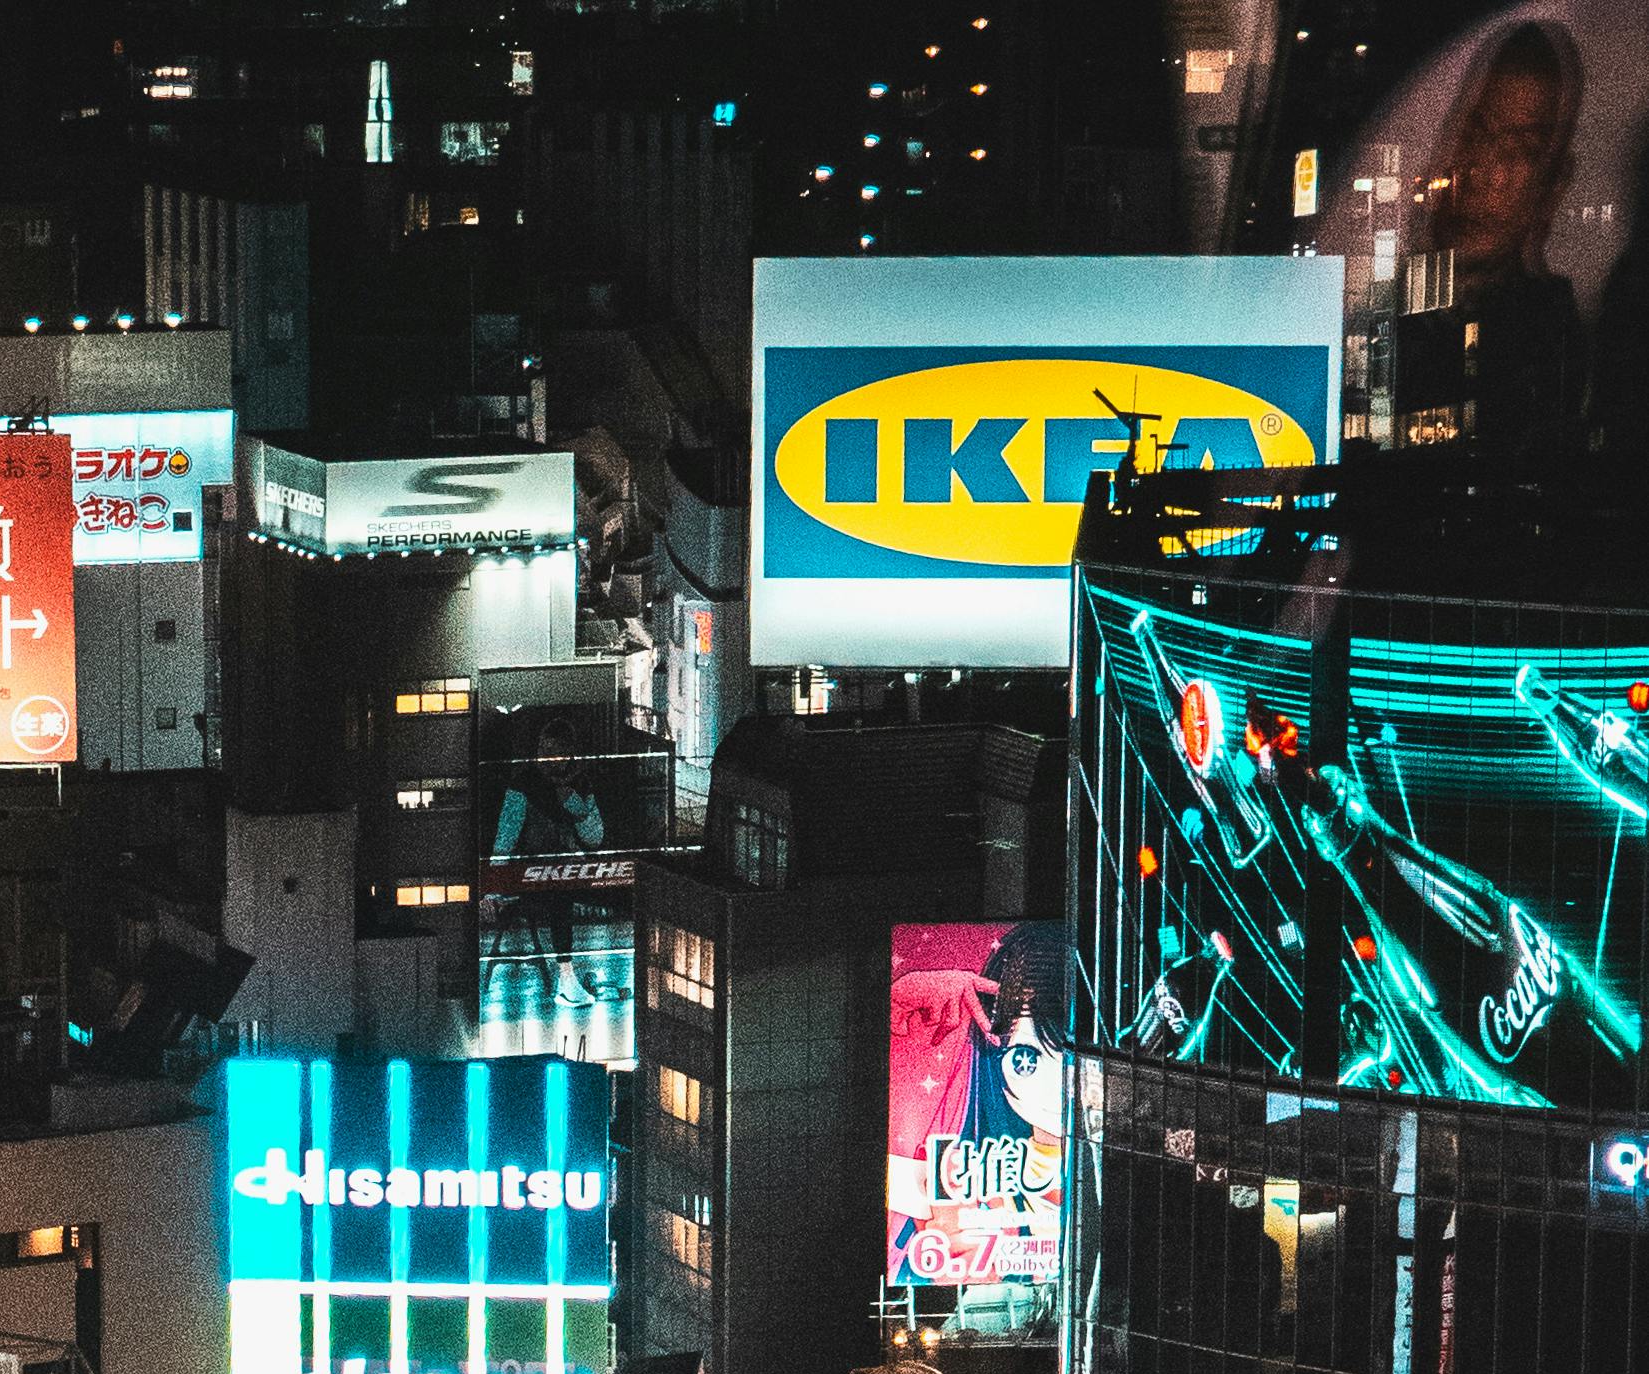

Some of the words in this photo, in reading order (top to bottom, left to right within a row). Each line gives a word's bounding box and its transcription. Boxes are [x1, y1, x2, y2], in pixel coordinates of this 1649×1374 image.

[265, 481, 325, 518] SKECHERS
[367, 520, 451, 534] SKECHERS
[367, 529, 532, 547] PERFORMANCE
[14, 710, 67, 738] 生薬
[234, 1148, 601, 1210] Hisamitsu
[913, 1232, 997, 1275] 6.7
